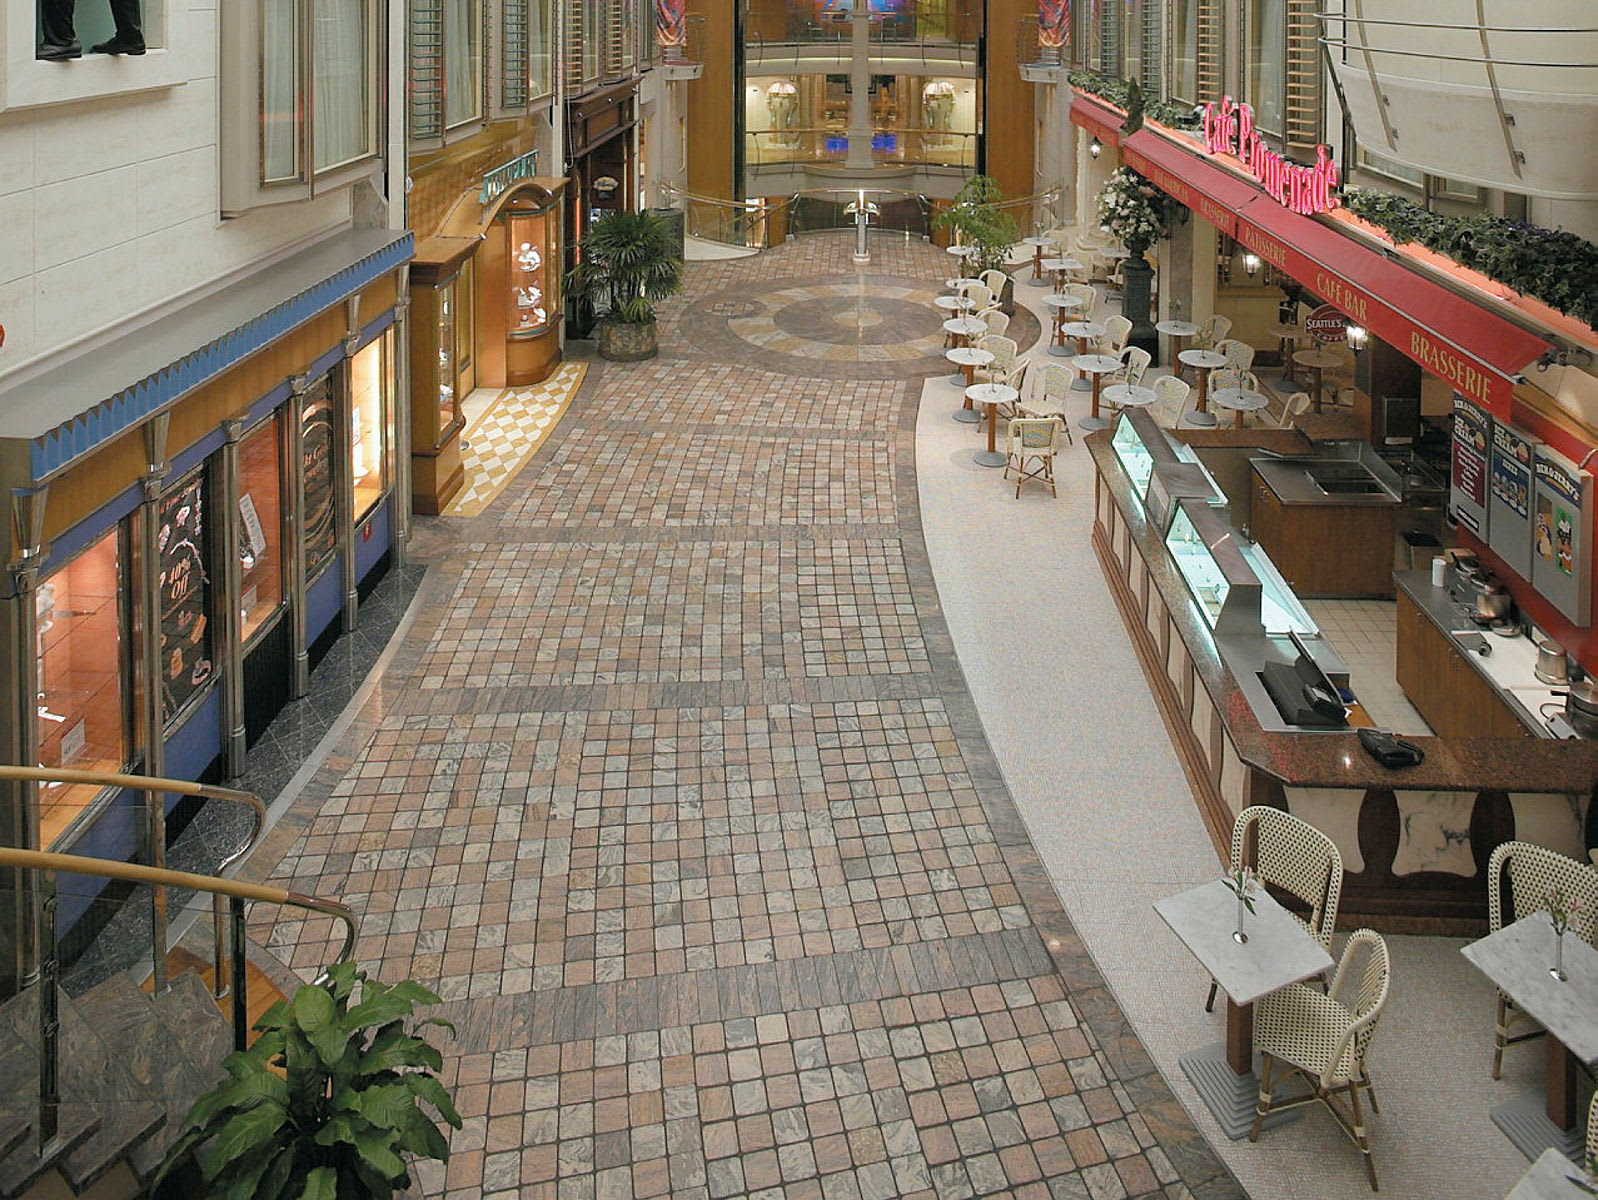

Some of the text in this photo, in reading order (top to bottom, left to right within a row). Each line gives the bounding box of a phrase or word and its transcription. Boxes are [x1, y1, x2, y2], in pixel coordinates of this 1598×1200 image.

[1239, 103, 1341, 215] Promenade
[1316, 273, 1342, 304] CAFÉ
[1344, 291, 1367, 321] BAR
[1410, 331, 1492, 404] BRASSERIE
